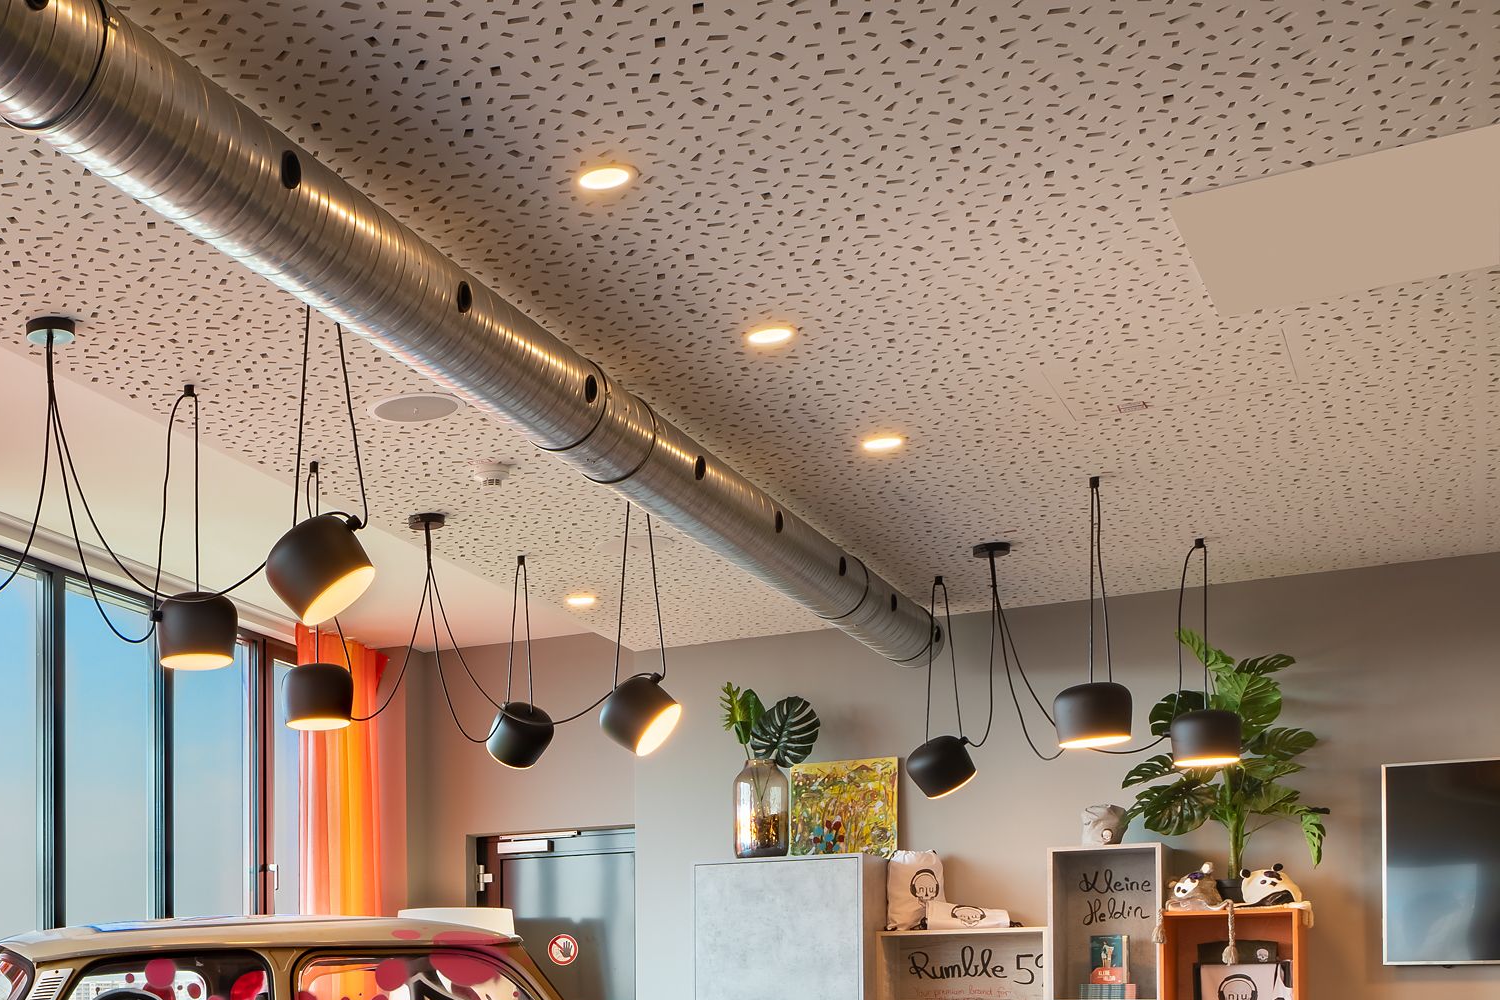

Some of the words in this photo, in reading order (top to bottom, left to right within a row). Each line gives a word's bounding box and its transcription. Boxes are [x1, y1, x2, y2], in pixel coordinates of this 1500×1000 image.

[1079, 869, 1152, 894] Kleine
[1083, 897, 1150, 926] Heldin
[908, 946, 1008, 979] Rumble
